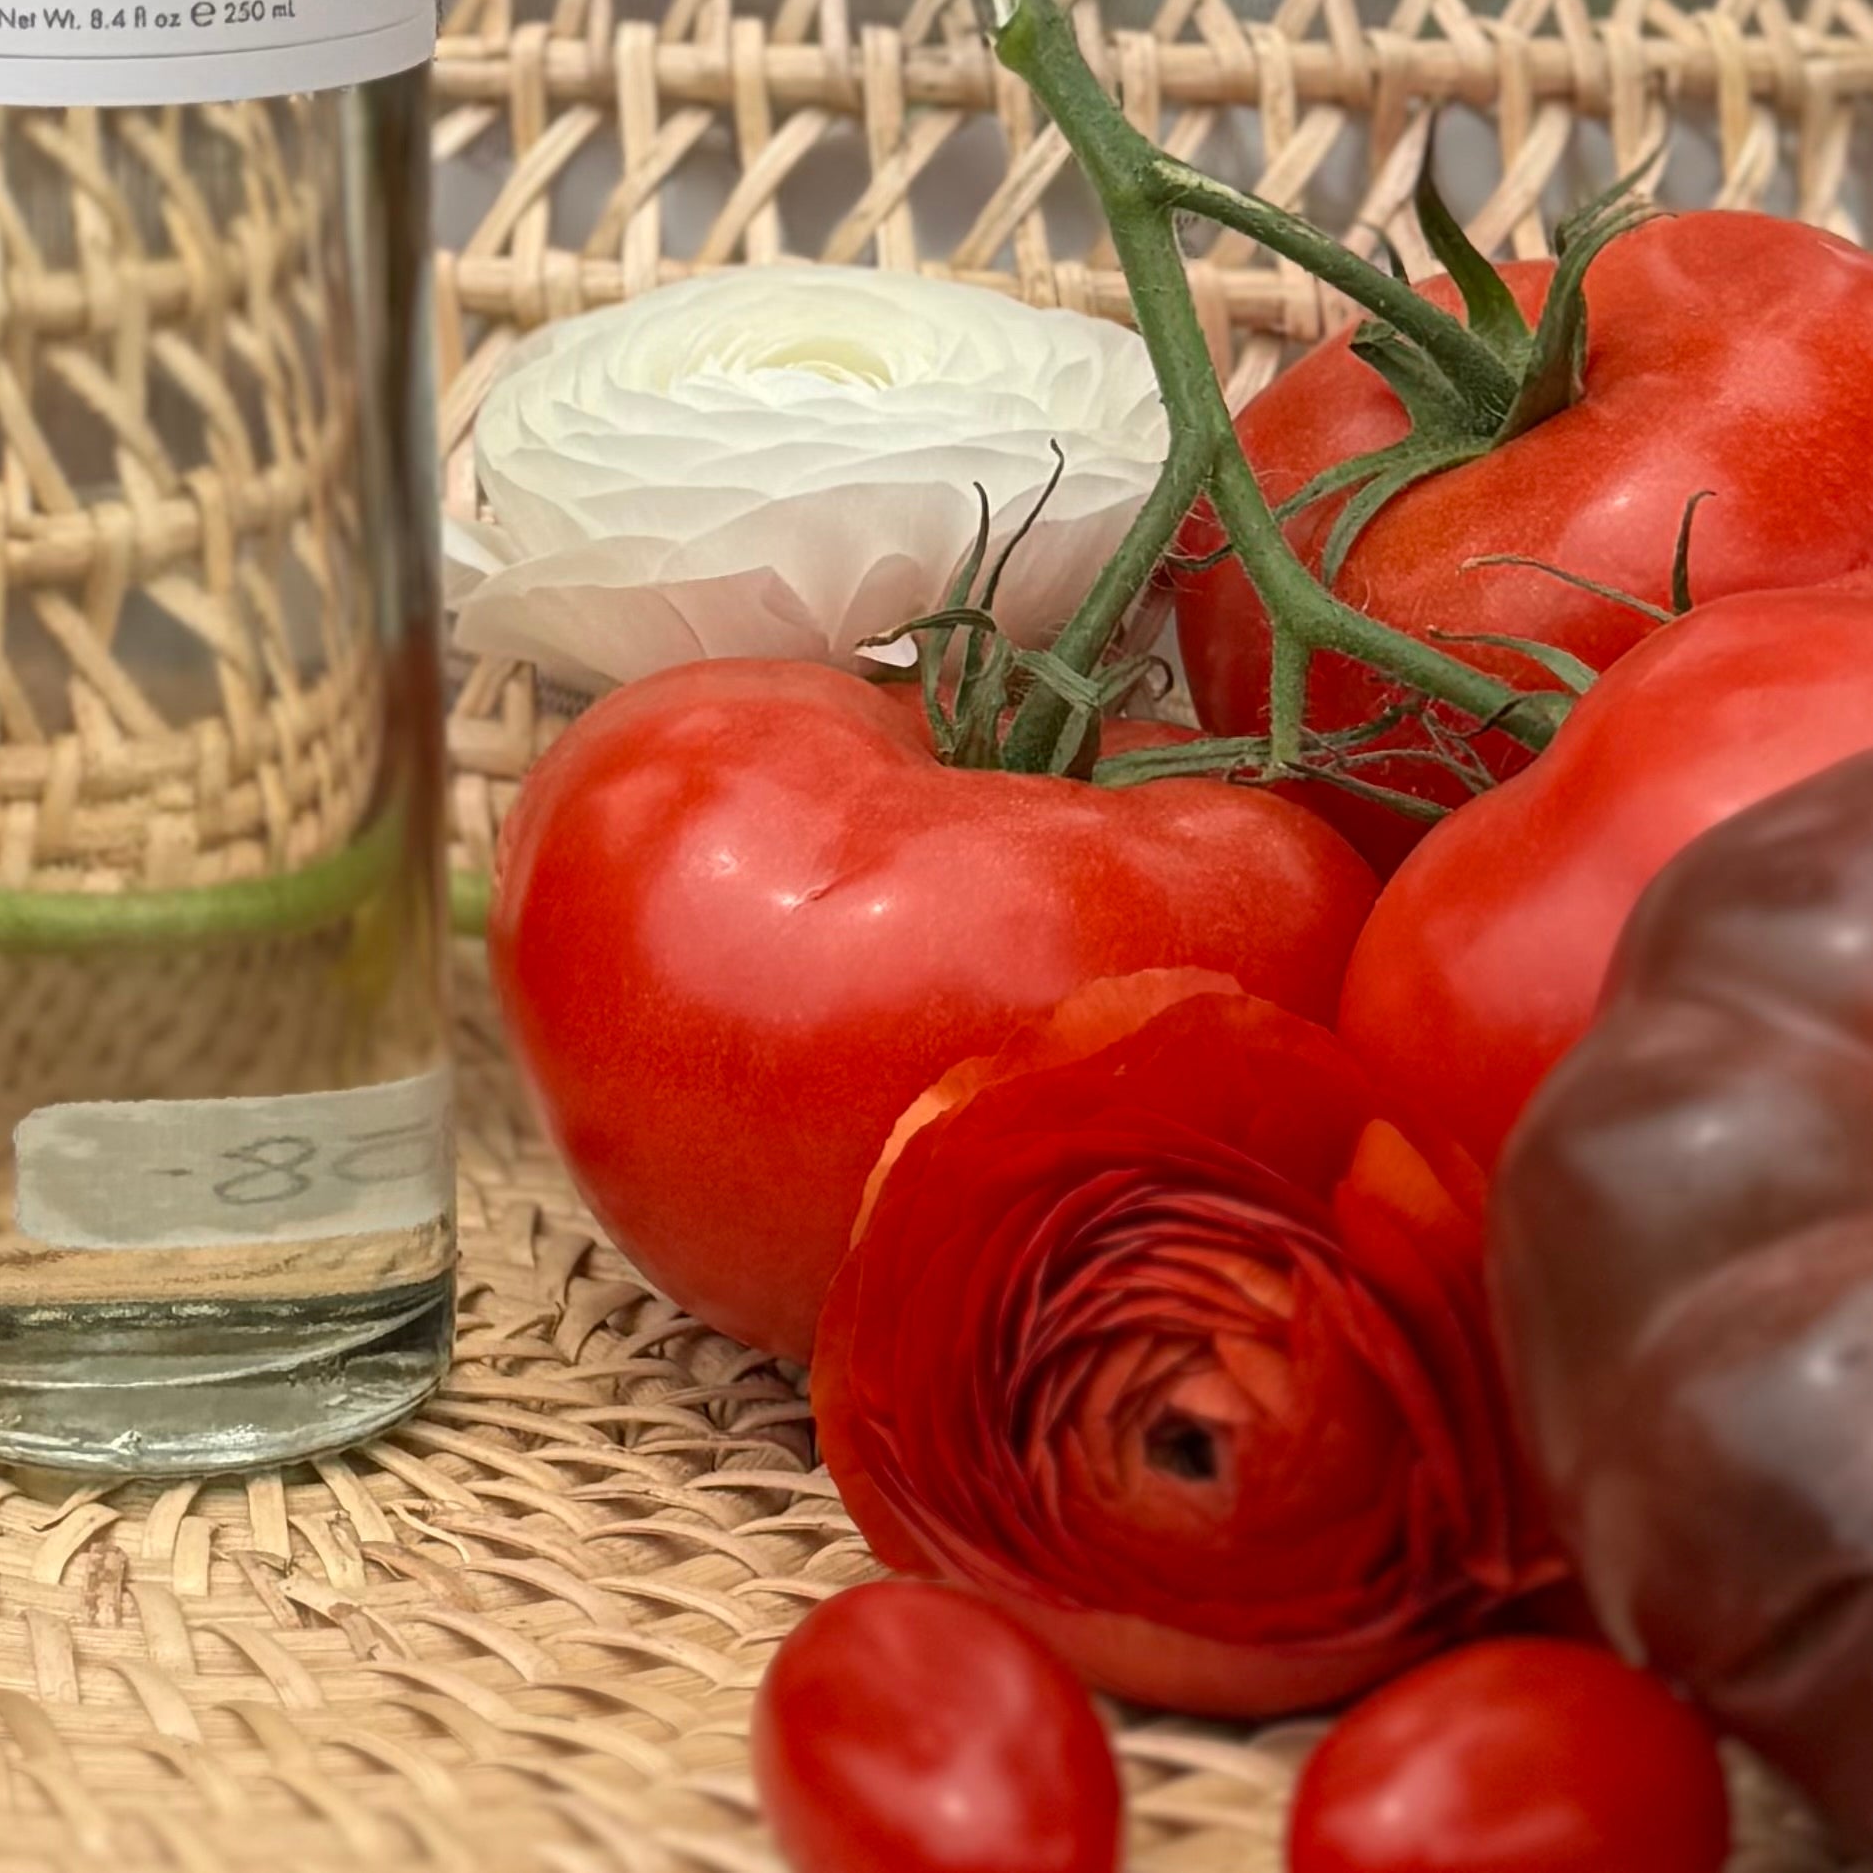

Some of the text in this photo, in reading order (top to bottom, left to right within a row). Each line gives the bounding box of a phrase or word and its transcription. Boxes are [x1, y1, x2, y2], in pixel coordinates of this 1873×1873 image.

[90, 8, 126, 30] 8.4
[133, 5, 147, 30] fl
[154, 12, 182, 29] oz
[223, 0, 266, 25] 250
